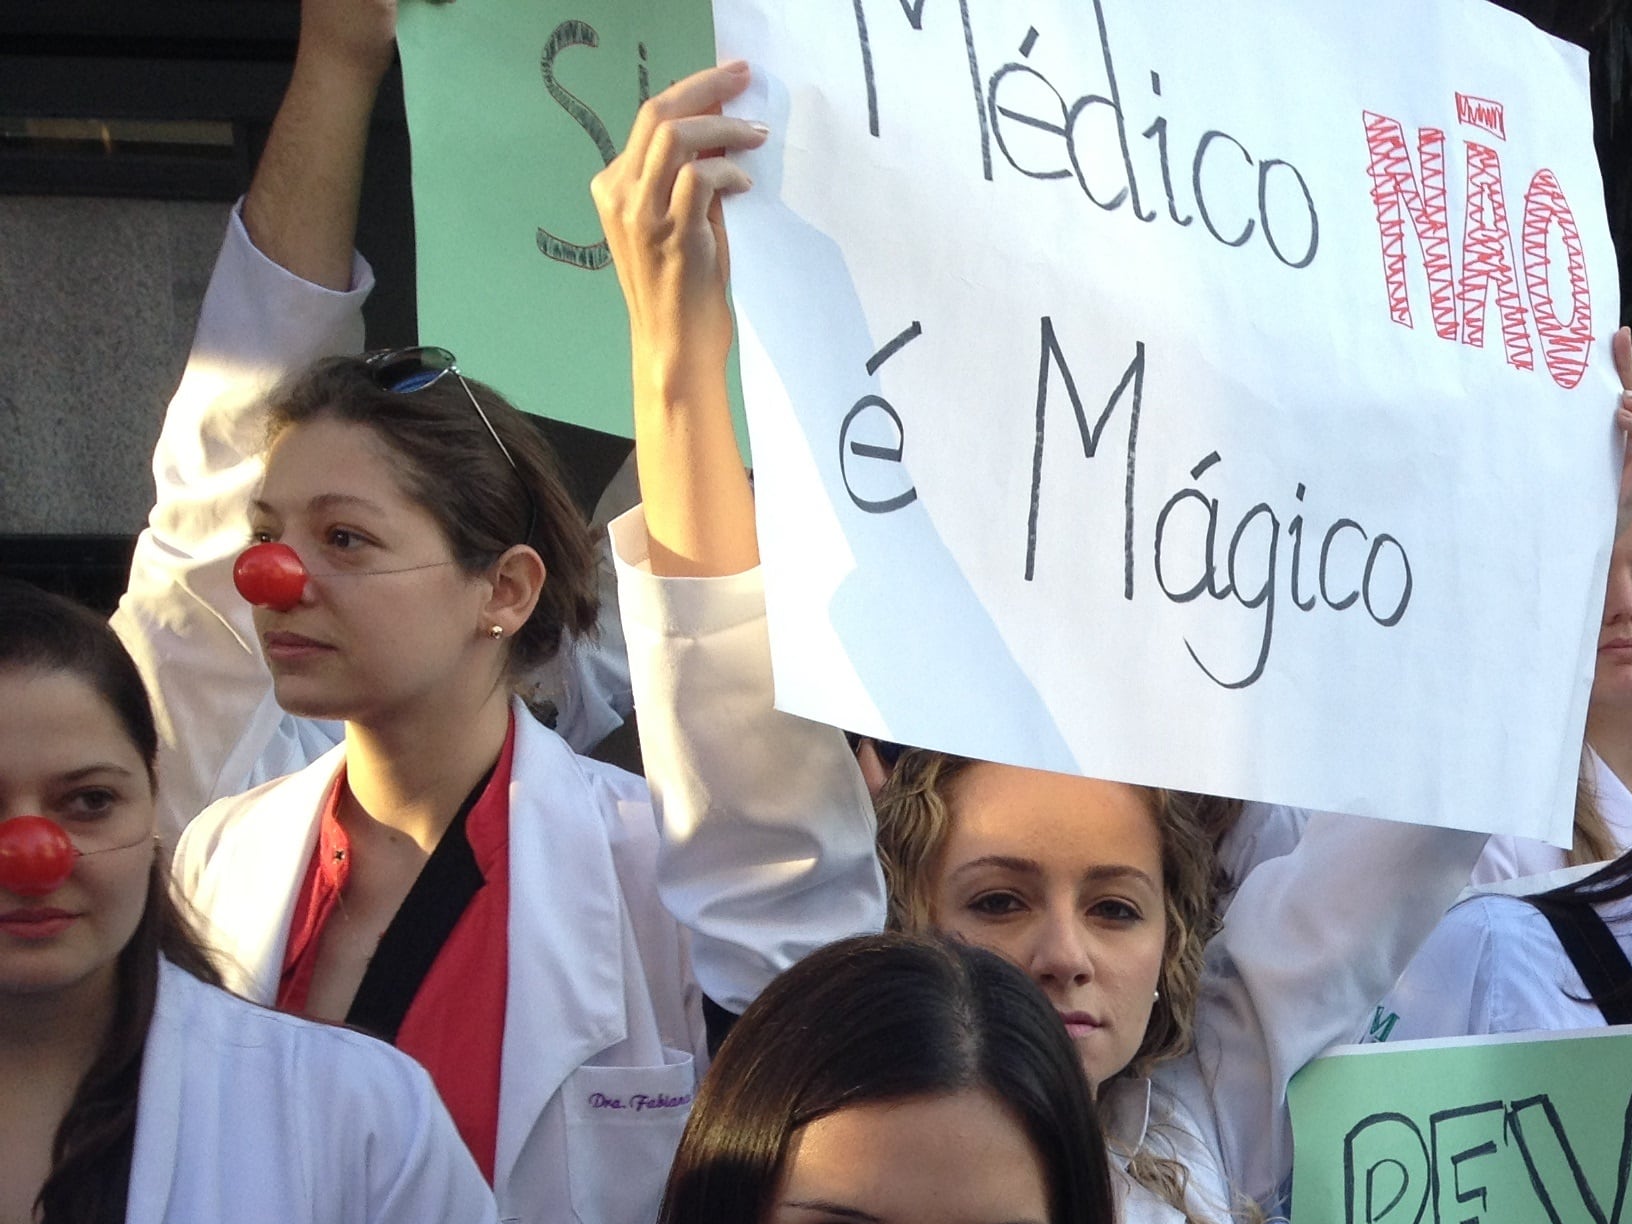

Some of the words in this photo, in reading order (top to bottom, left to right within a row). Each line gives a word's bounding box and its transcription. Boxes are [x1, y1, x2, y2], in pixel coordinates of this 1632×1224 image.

[852, 0, 1319, 269] Médico
[1362, 91, 1593, 390] NÃO
[838, 320, 922, 514] é
[1024, 315, 1413, 689] Mágico
[588, 1092, 626, 1110] Dra.
